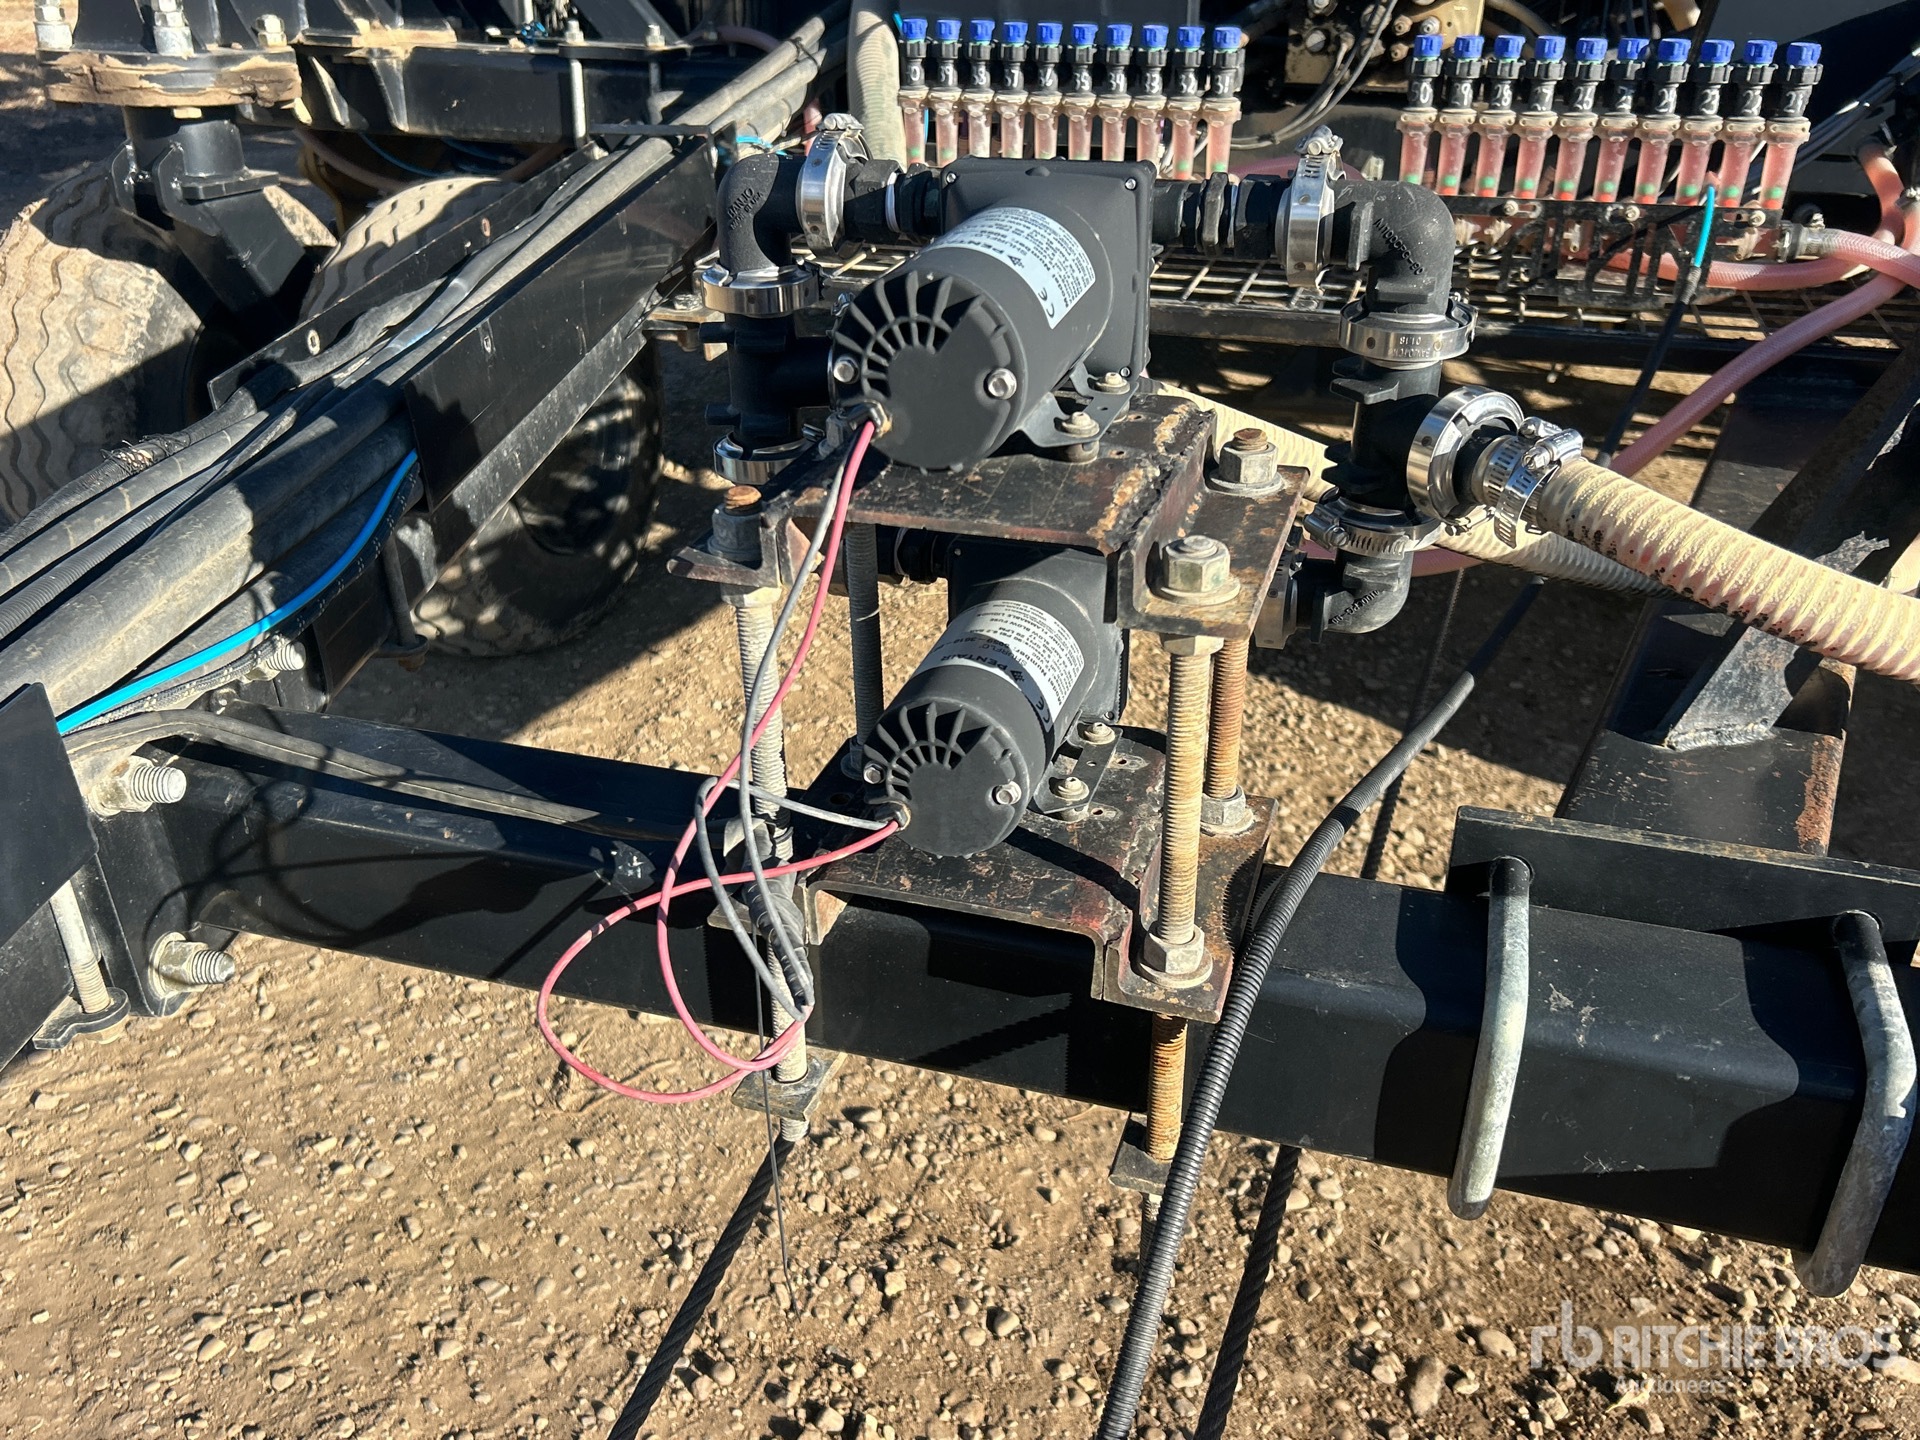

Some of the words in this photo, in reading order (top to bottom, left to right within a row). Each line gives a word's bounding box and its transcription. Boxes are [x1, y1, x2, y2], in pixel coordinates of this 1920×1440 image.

[1109, 72, 1124, 92] 34
[1216, 75, 1230, 94] 31
[940, 654, 1008, 671] PENTAIR
